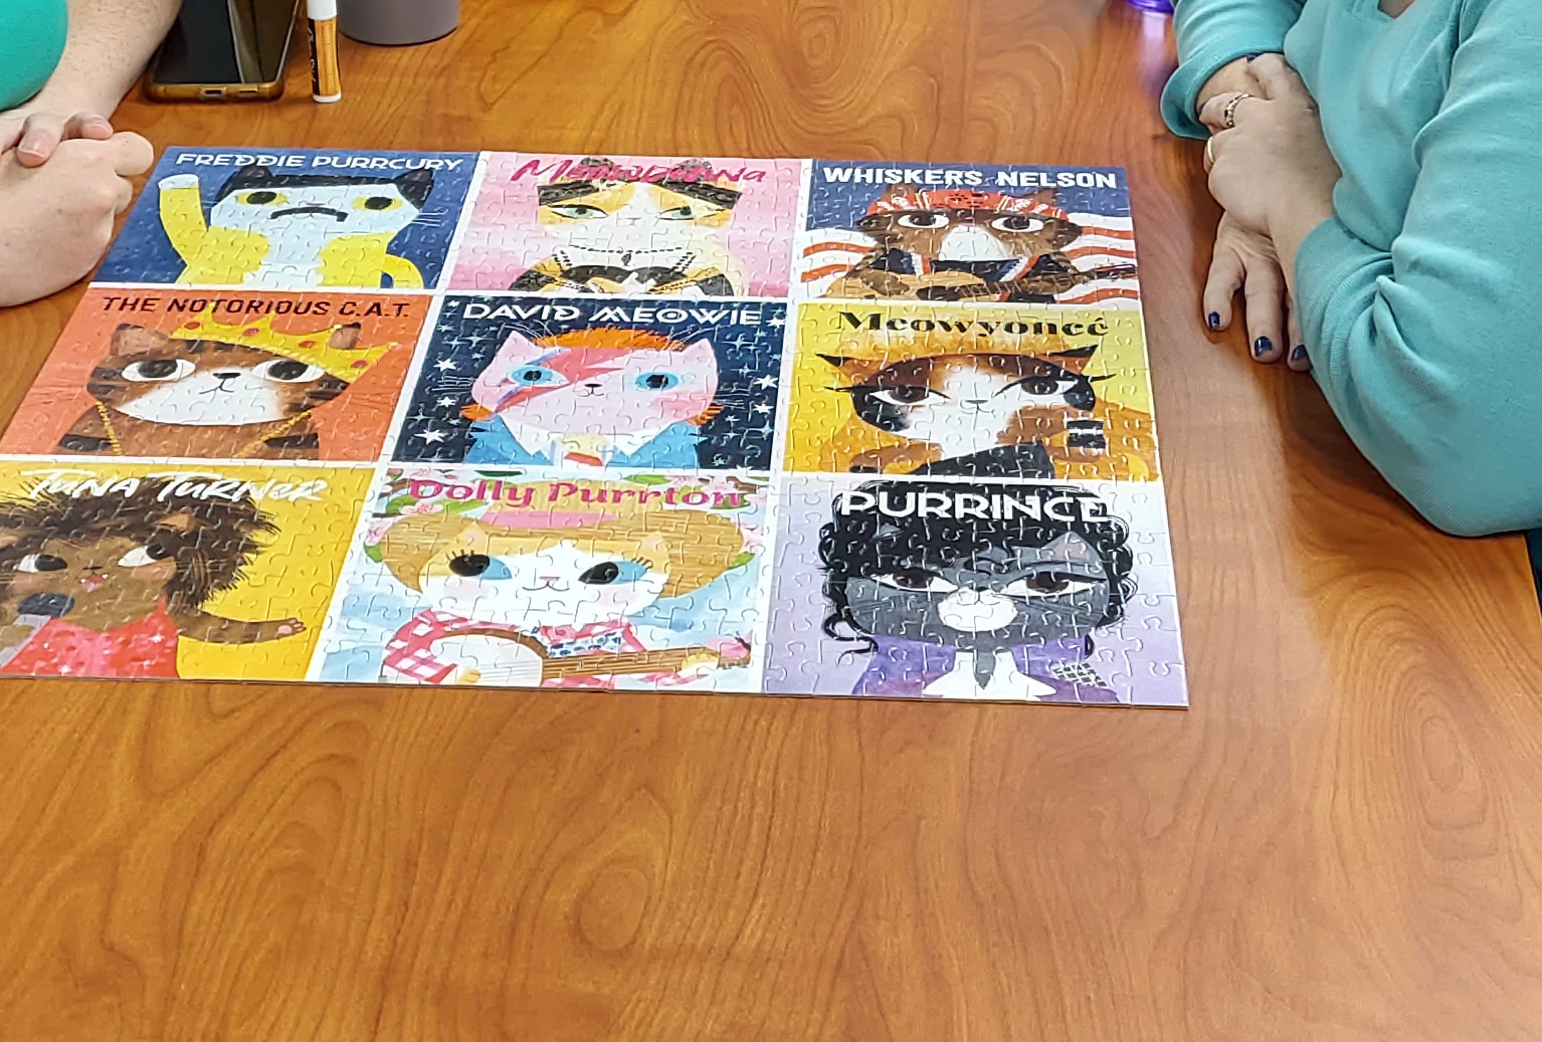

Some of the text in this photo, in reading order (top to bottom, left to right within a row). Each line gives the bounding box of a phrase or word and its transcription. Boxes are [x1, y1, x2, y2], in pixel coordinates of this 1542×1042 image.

[176, 153, 463, 171] FREDDIE PURRCURY
[823, 166, 1118, 189] WHISKERS NELSON
[103, 296, 411, 318] THE NOTORIOUS C.A.T.
[463, 303, 761, 325] DAVID MEOWIE
[837, 311, 1109, 337] Meowyoncé
[409, 478, 743, 508] Dolly Purrton
[840, 490, 1111, 523] PURRINCE
